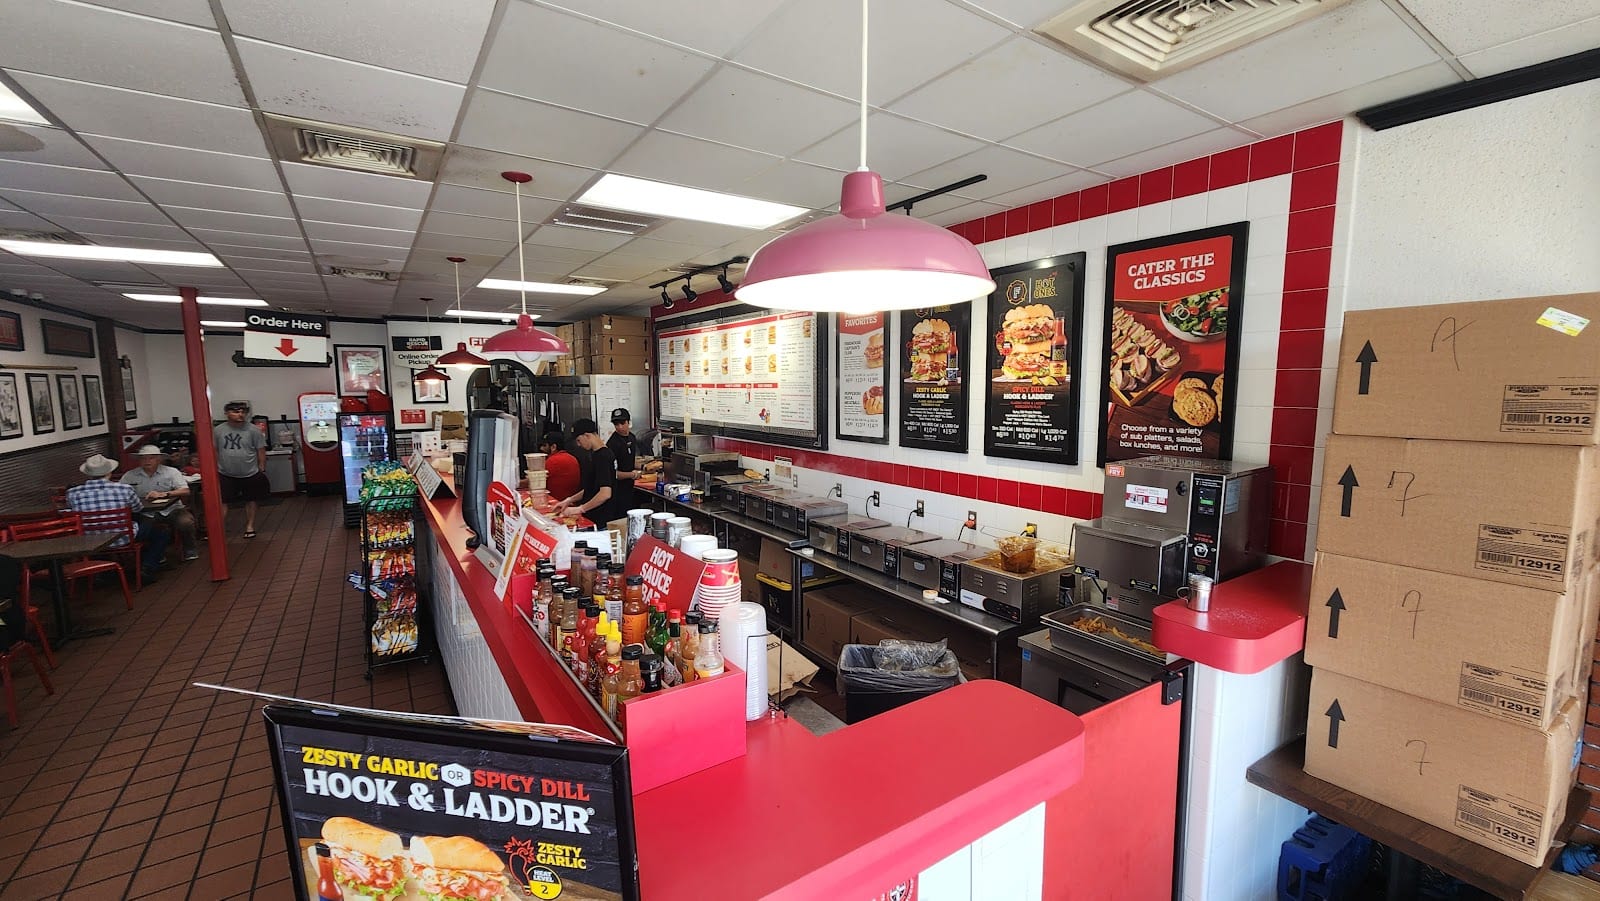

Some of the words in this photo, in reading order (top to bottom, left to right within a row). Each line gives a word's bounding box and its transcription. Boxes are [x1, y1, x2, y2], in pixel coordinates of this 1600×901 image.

[1128, 260, 1176, 276] CATER
[1180, 253, 1214, 269] THE
[1036, 278, 1055, 288] HOT
[1134, 270, 1206, 290] CLASSICS
[248, 315, 289, 327] Order
[292, 320, 322, 330] Here
[845, 317, 877, 327] FAVORITES
[1546, 416, 1591, 424] 12912
[1176, 427, 1202, 436] variety
[1134, 442, 1162, 451] lunches,
[1144, 434, 1174, 443] platters,
[1176, 436, 1202, 445] salads,
[650, 546, 675, 572] HOT
[1519, 558, 1561, 572] 12912
[640, 562, 672, 595] SAUCE
[1402, 590, 1424, 640] 7
[1500, 700, 1540, 717] 12912
[1406, 739, 1432, 776] 7
[302, 746, 362, 769] ZESTY
[367, 755, 439, 780] GARLIC
[448, 770, 463, 780] OR
[474, 770, 534, 793] SPICY
[541, 778, 590, 801] DILL
[303, 768, 400, 806] HOOK
[408, 782, 436, 812] &
[1496, 827, 1535, 846] 12912
[537, 842, 582, 857] ZESTY
[536, 854, 586, 869] GARLIC
[540, 885, 548, 894] 2
